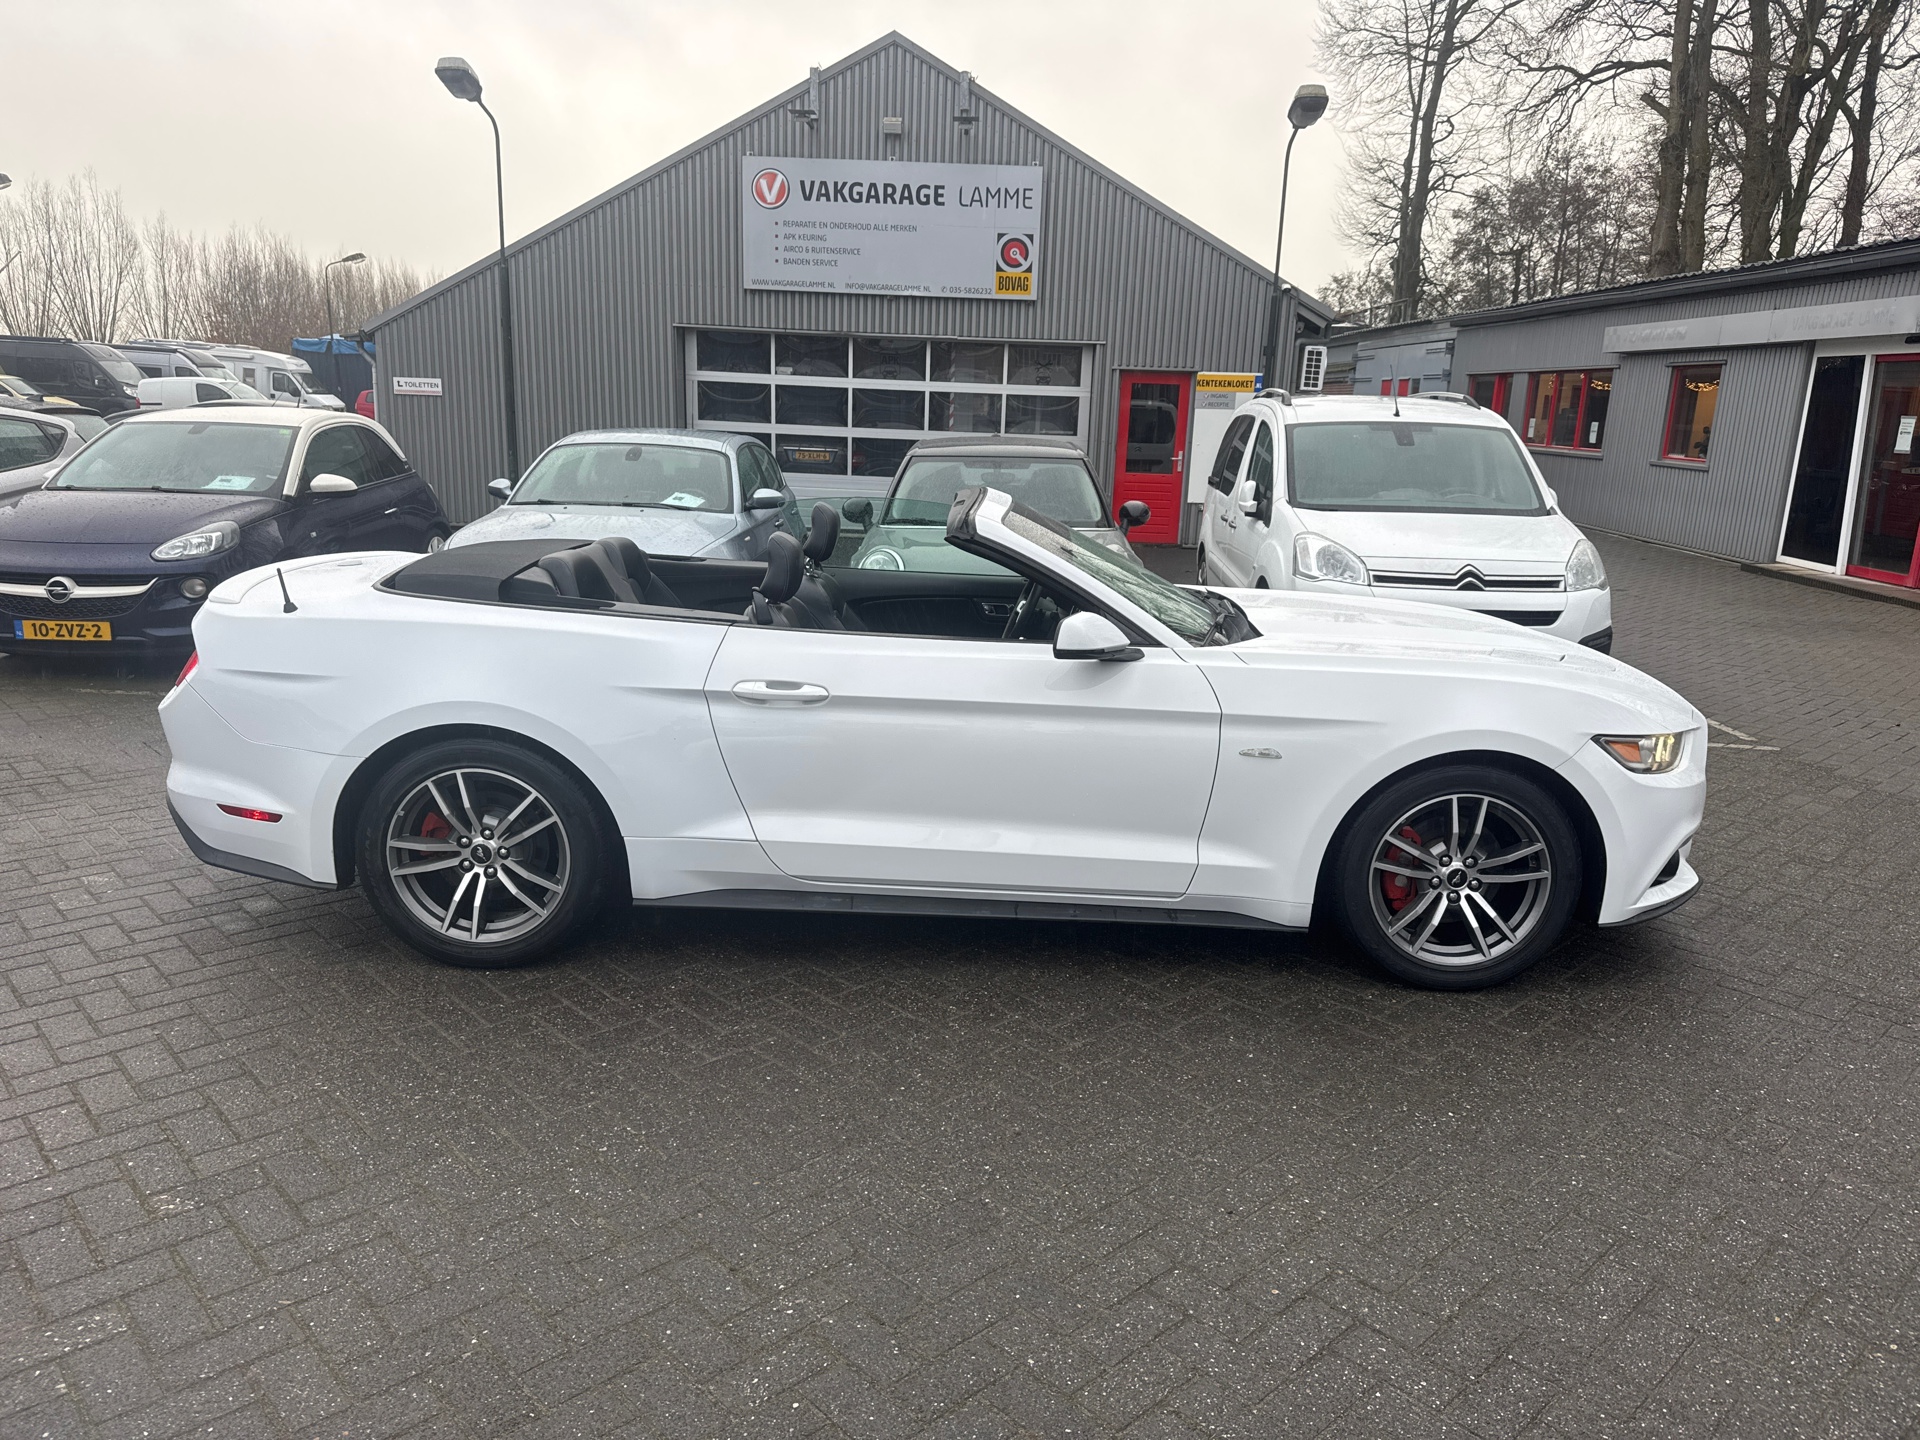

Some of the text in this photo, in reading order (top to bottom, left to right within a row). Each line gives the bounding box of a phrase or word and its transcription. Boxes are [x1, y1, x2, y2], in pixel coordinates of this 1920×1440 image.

[799, 179, 1034, 209] VAKGARAGE LAMME
[782, 220, 918, 233] REPARATIE EN ONDERHOUD ALLE MERKEN
[783, 232, 828, 242] APK KEURING
[783, 245, 861, 256] AIRCO & RUITENSERVICE
[783, 257, 839, 267] BANDEN SERVICE
[751, 278, 836, 289] WWW.VAKGARAGELAMME.NL
[844, 282, 931, 293] INFO@VAKGARAGELAMME.NL
[998, 276, 1029, 292] BOVAG
[949, 286, 993, 295] 035-5826232
[880, 354, 900, 365] APK
[403, 381, 439, 389] TOILETTEN
[1196, 379, 1254, 389] KENTEKENLOKET
[31, 622, 103, 639] 10-ZVZ-2
